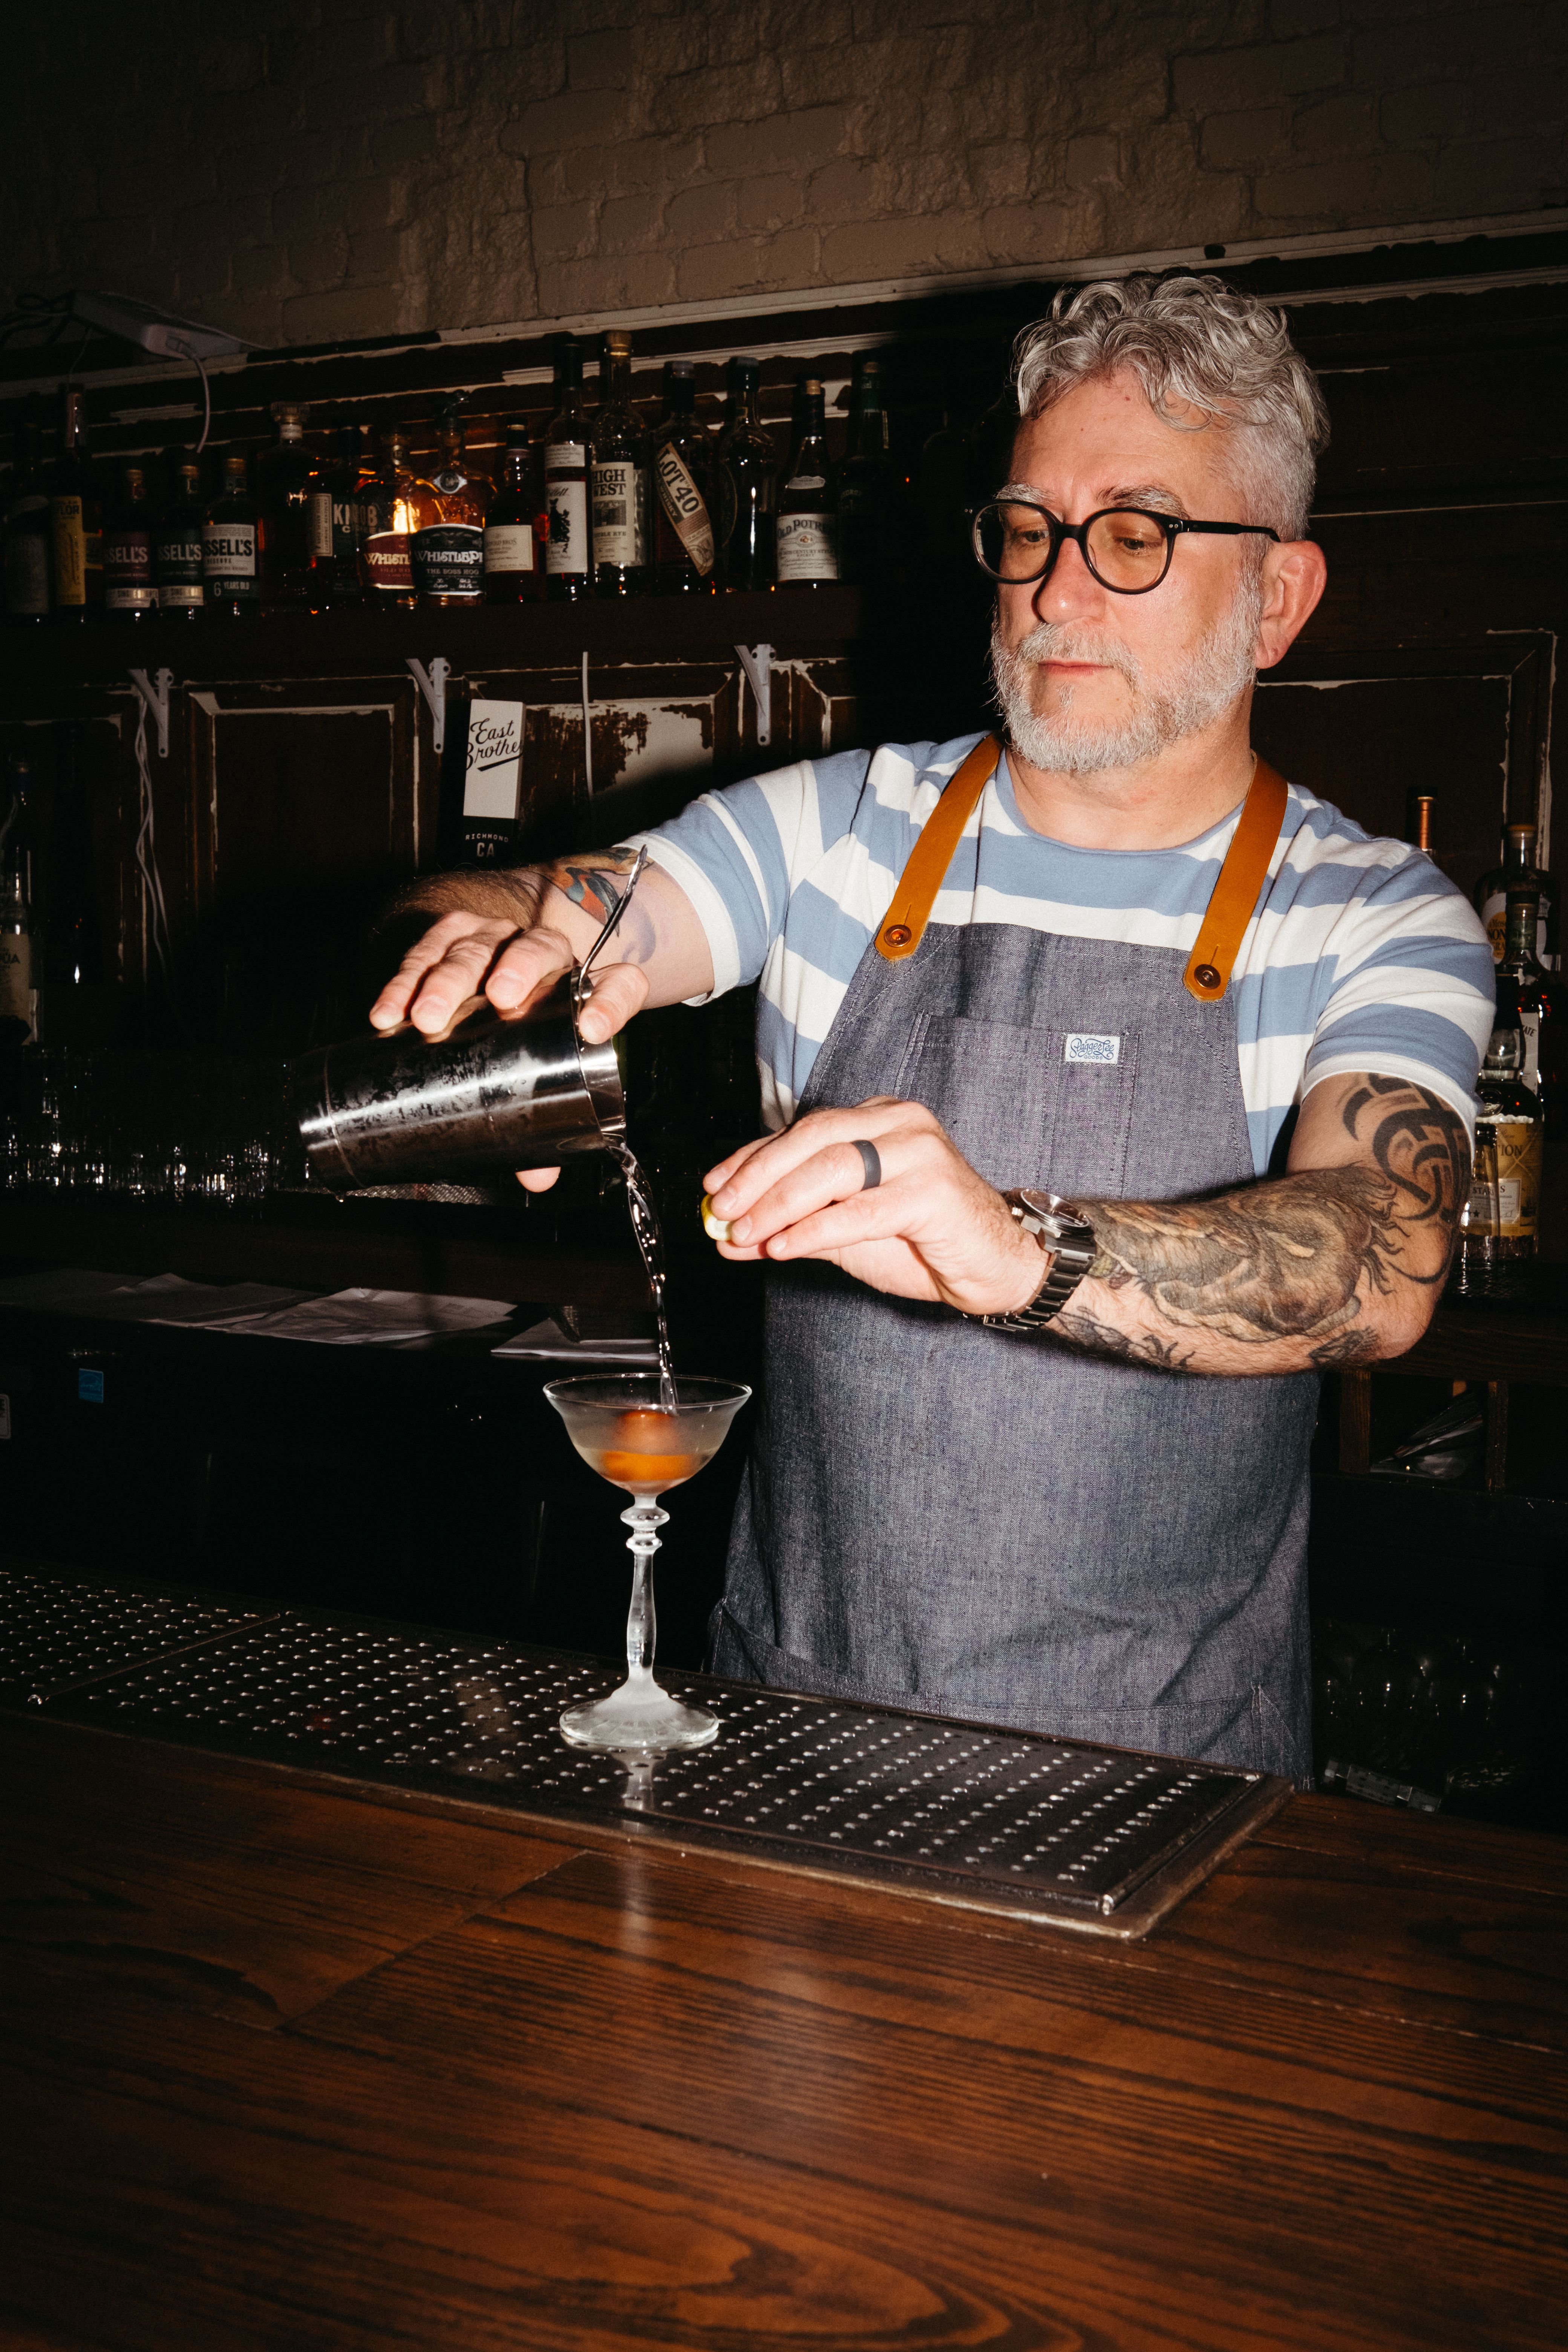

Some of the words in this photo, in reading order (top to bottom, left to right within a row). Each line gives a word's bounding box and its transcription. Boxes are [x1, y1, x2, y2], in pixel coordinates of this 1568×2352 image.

[593, 469, 626, 484] HIGH
[675, 487, 699, 513] 40
[214, 582, 222, 596] 6
[470, 718, 514, 745] East
[465, 833, 509, 842] RICHMOND
[477, 842, 495, 857] CA
[1523, 1025, 1537, 1037] ATE
